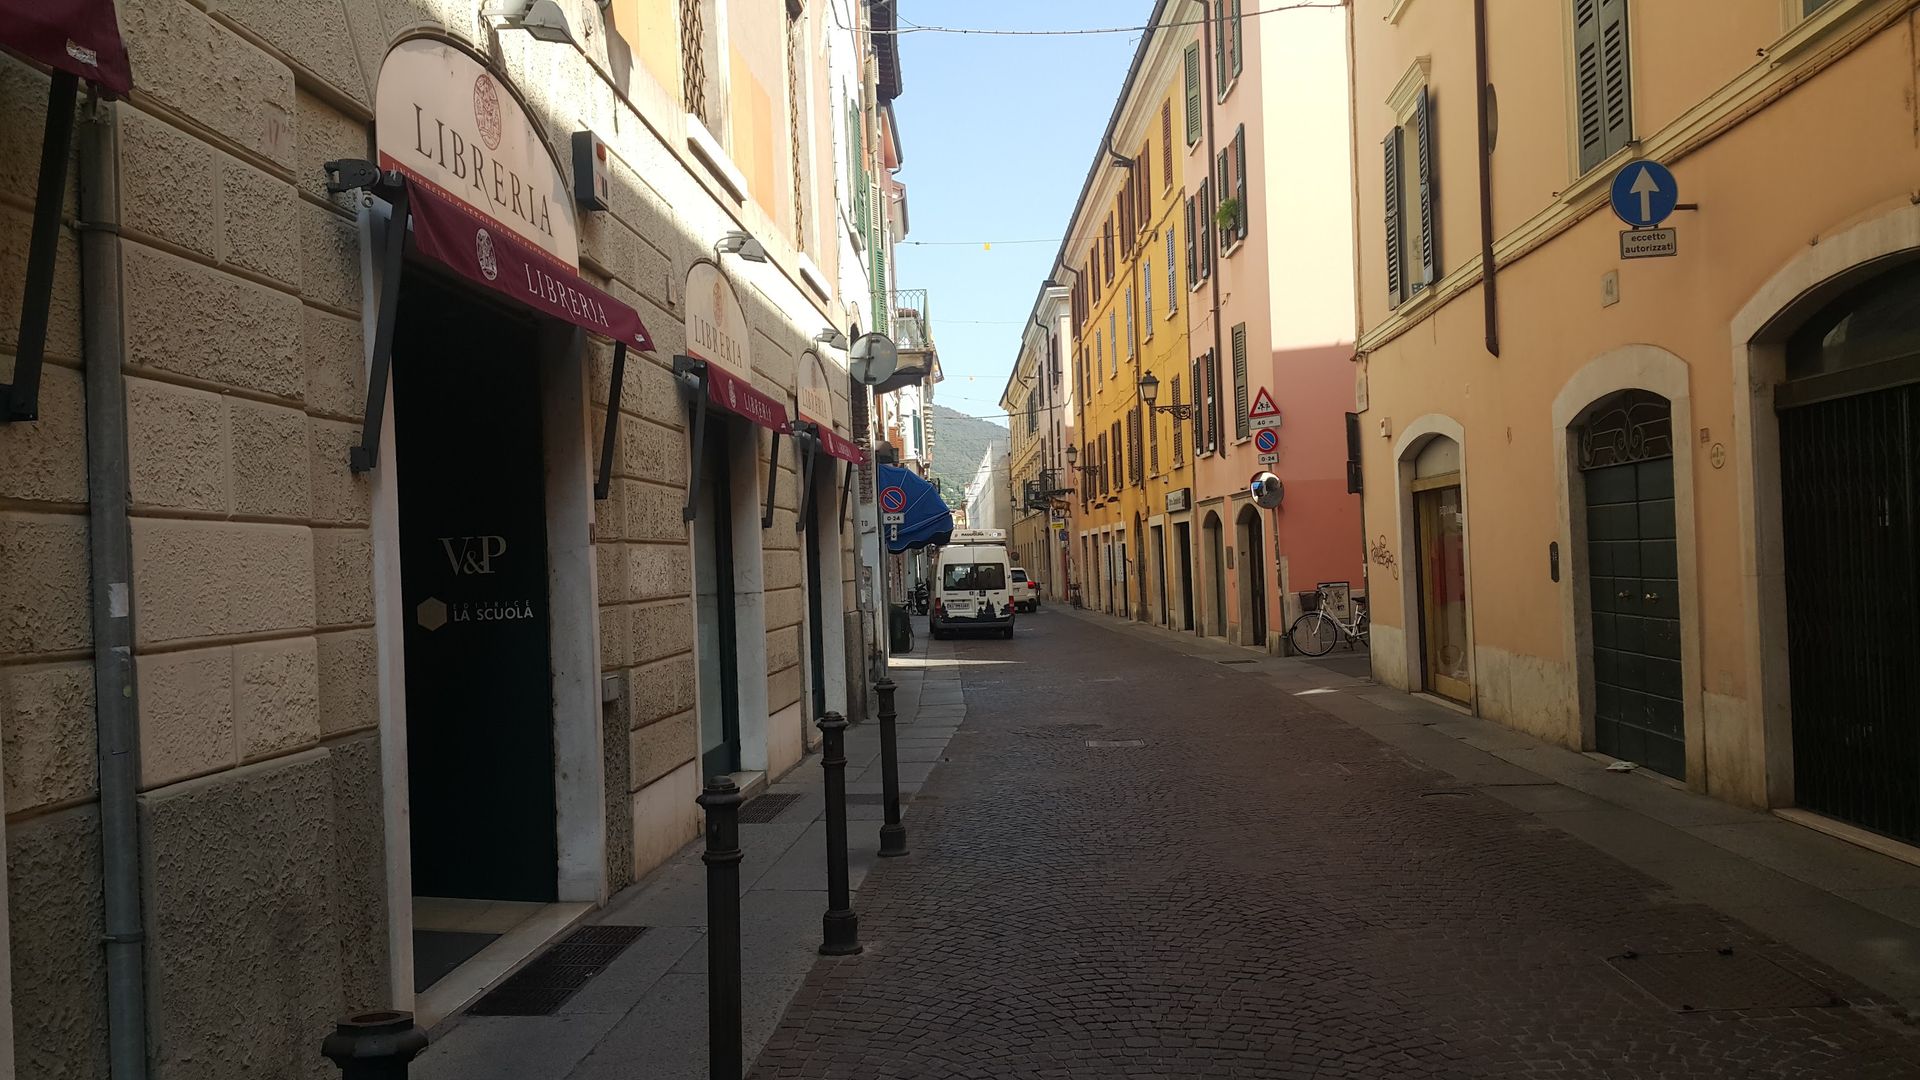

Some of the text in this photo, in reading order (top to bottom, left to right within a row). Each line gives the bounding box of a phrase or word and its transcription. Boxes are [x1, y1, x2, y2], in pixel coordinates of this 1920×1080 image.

[413, 103, 553, 237] LIBRERIA
[1625, 243, 1674, 254] autorizzati
[1631, 233, 1666, 242] eccetto
[525, 263, 609, 328] LIBRERIA
[694, 315, 742, 369] LIBRERIA
[743, 392, 772, 422] LIBRERIA
[438, 535, 507, 576] V&P
[454, 607, 534, 621] LA SCUOLA
